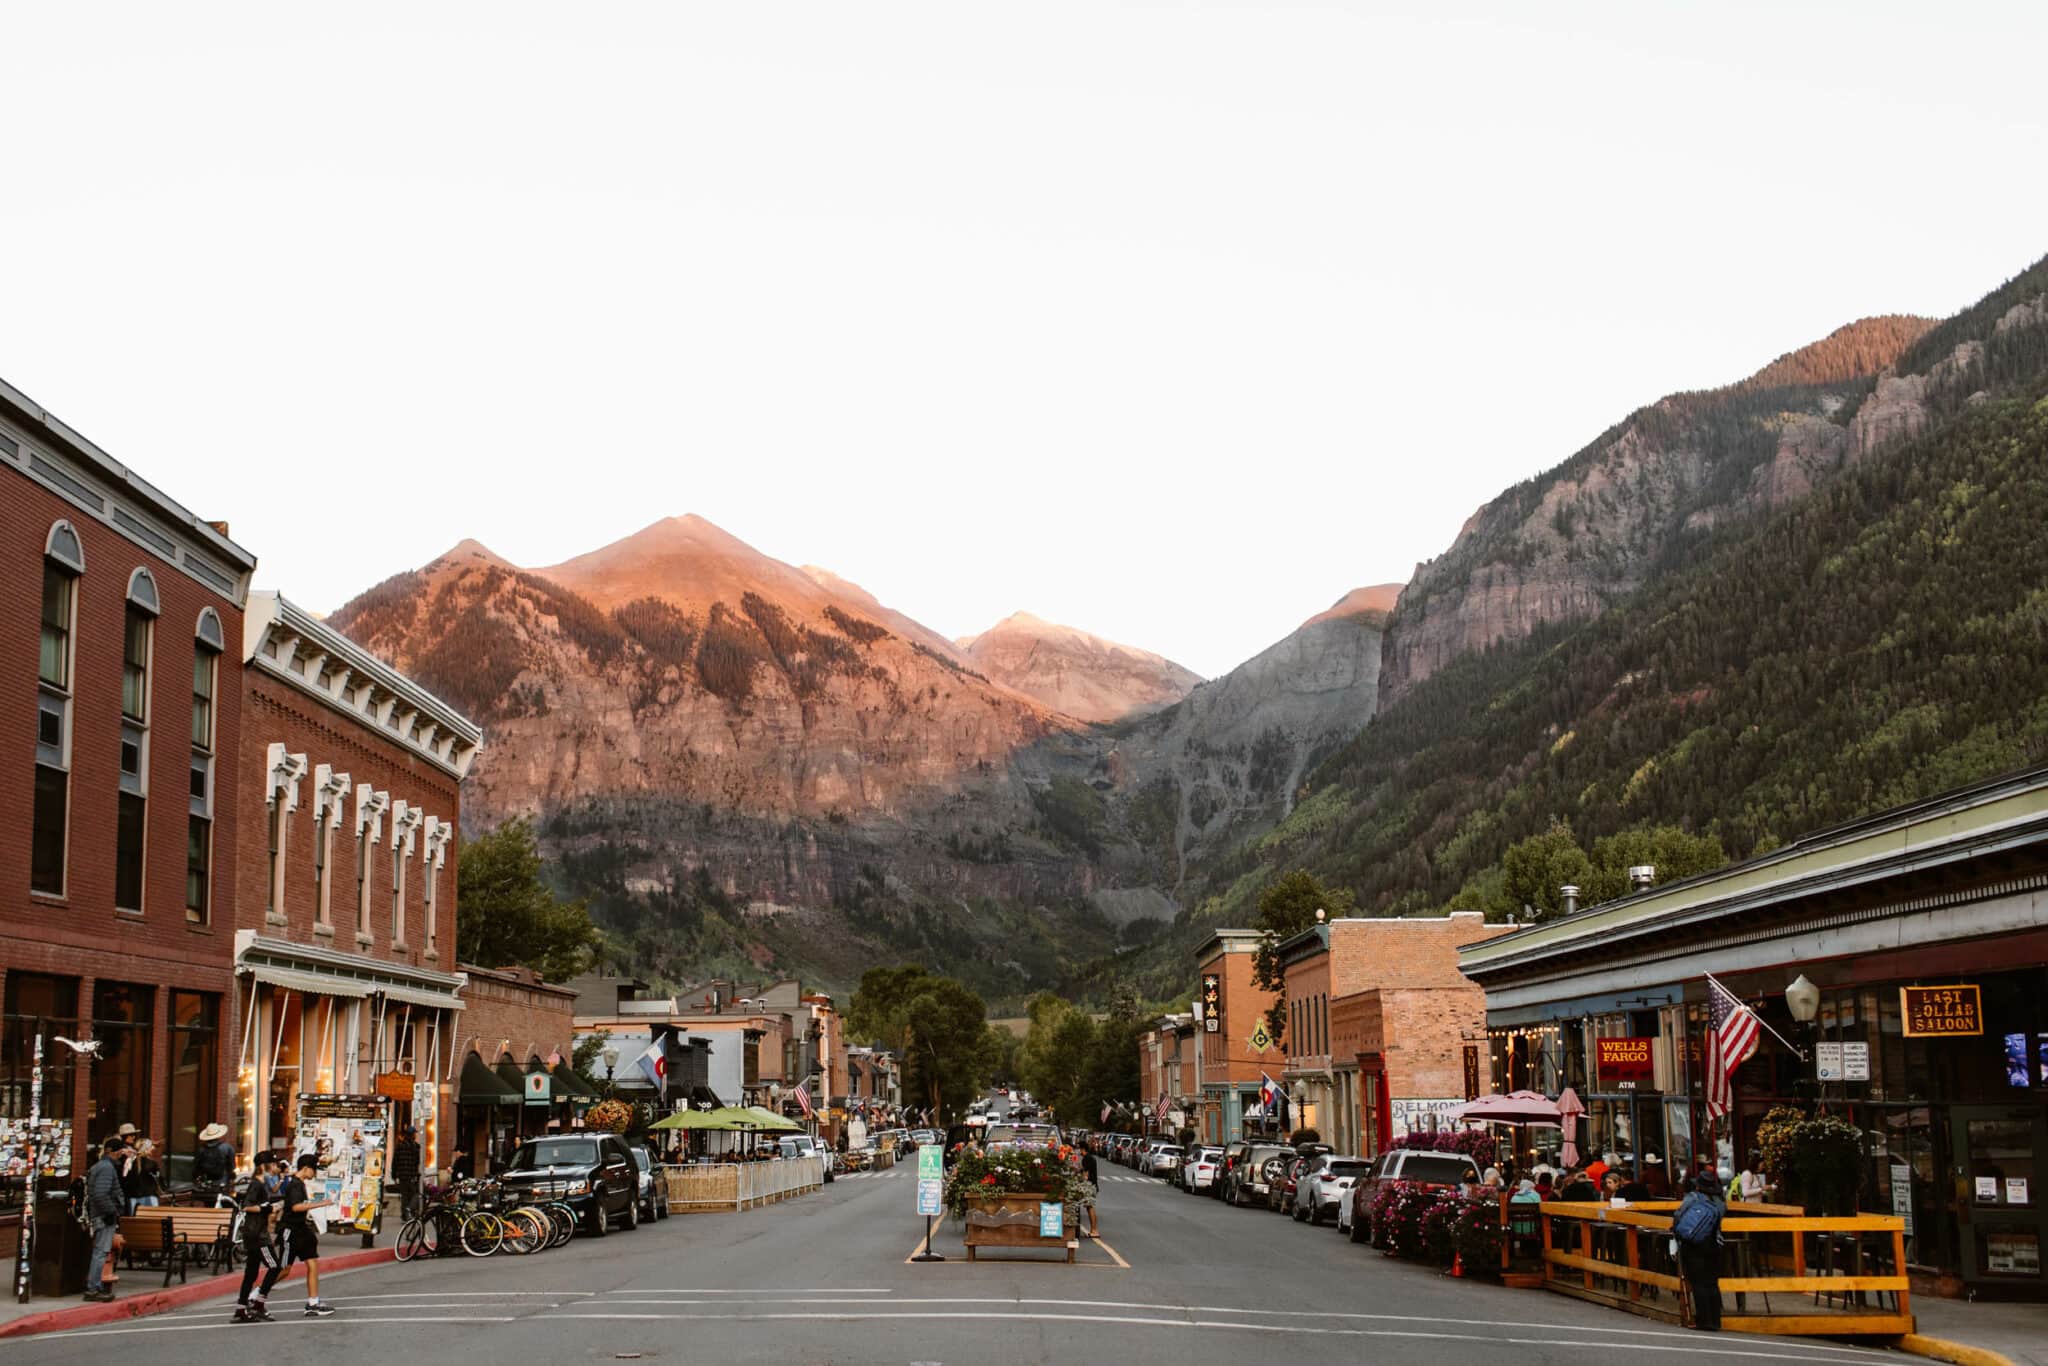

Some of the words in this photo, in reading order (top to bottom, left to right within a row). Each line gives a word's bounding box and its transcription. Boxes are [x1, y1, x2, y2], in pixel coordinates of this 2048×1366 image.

[1915, 1018, 1974, 1031] SALOON
[1601, 1042, 1648, 1052] WELLS
[1603, 1052, 1648, 1062] FARGO
[1393, 1101, 1460, 1119] BELMON
